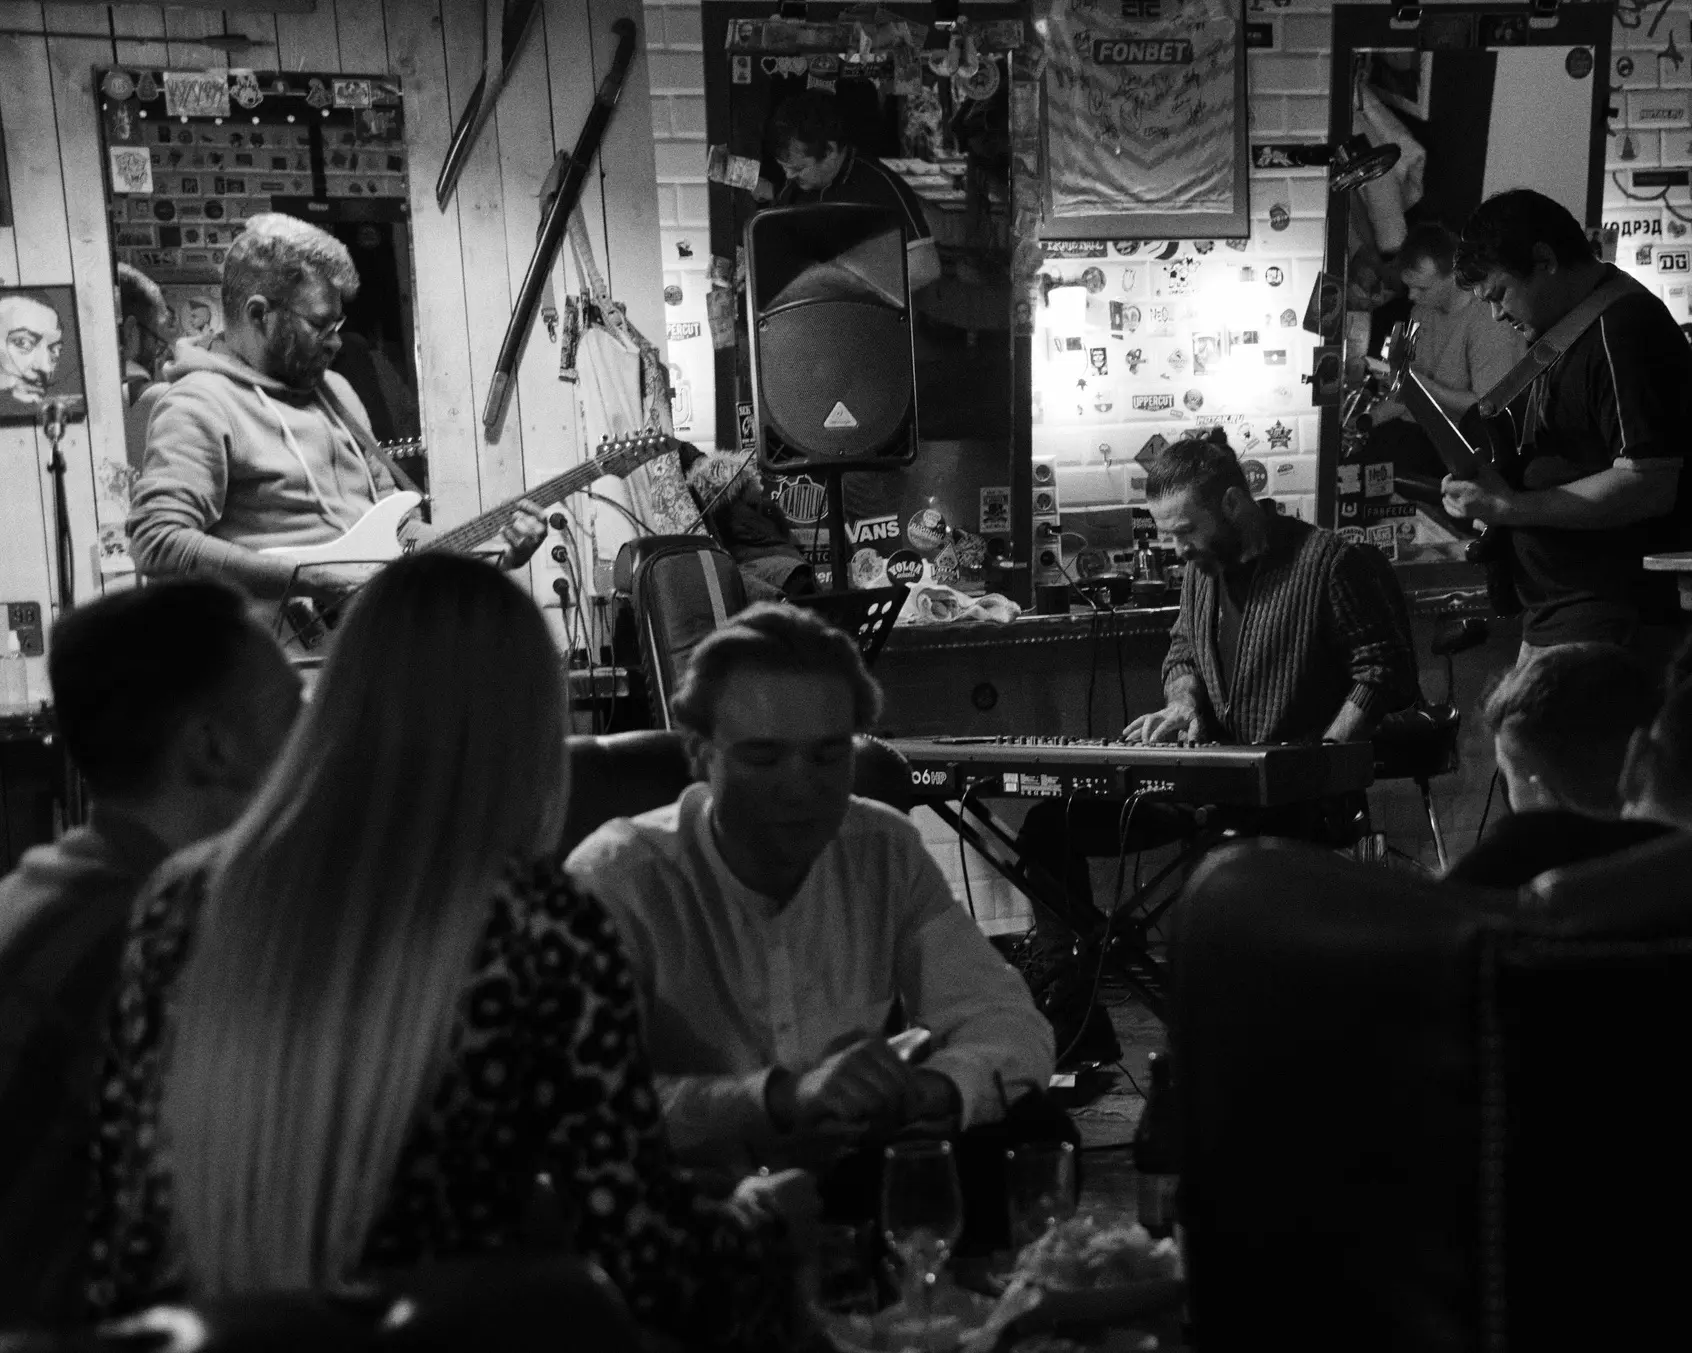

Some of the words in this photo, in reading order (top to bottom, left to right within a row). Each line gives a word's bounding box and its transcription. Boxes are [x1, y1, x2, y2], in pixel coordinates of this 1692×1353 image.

[1098, 42, 1188, 61] FONBET
[1132, 395, 1174, 408] UPPERCUT
[844, 515, 900, 544] VANS
